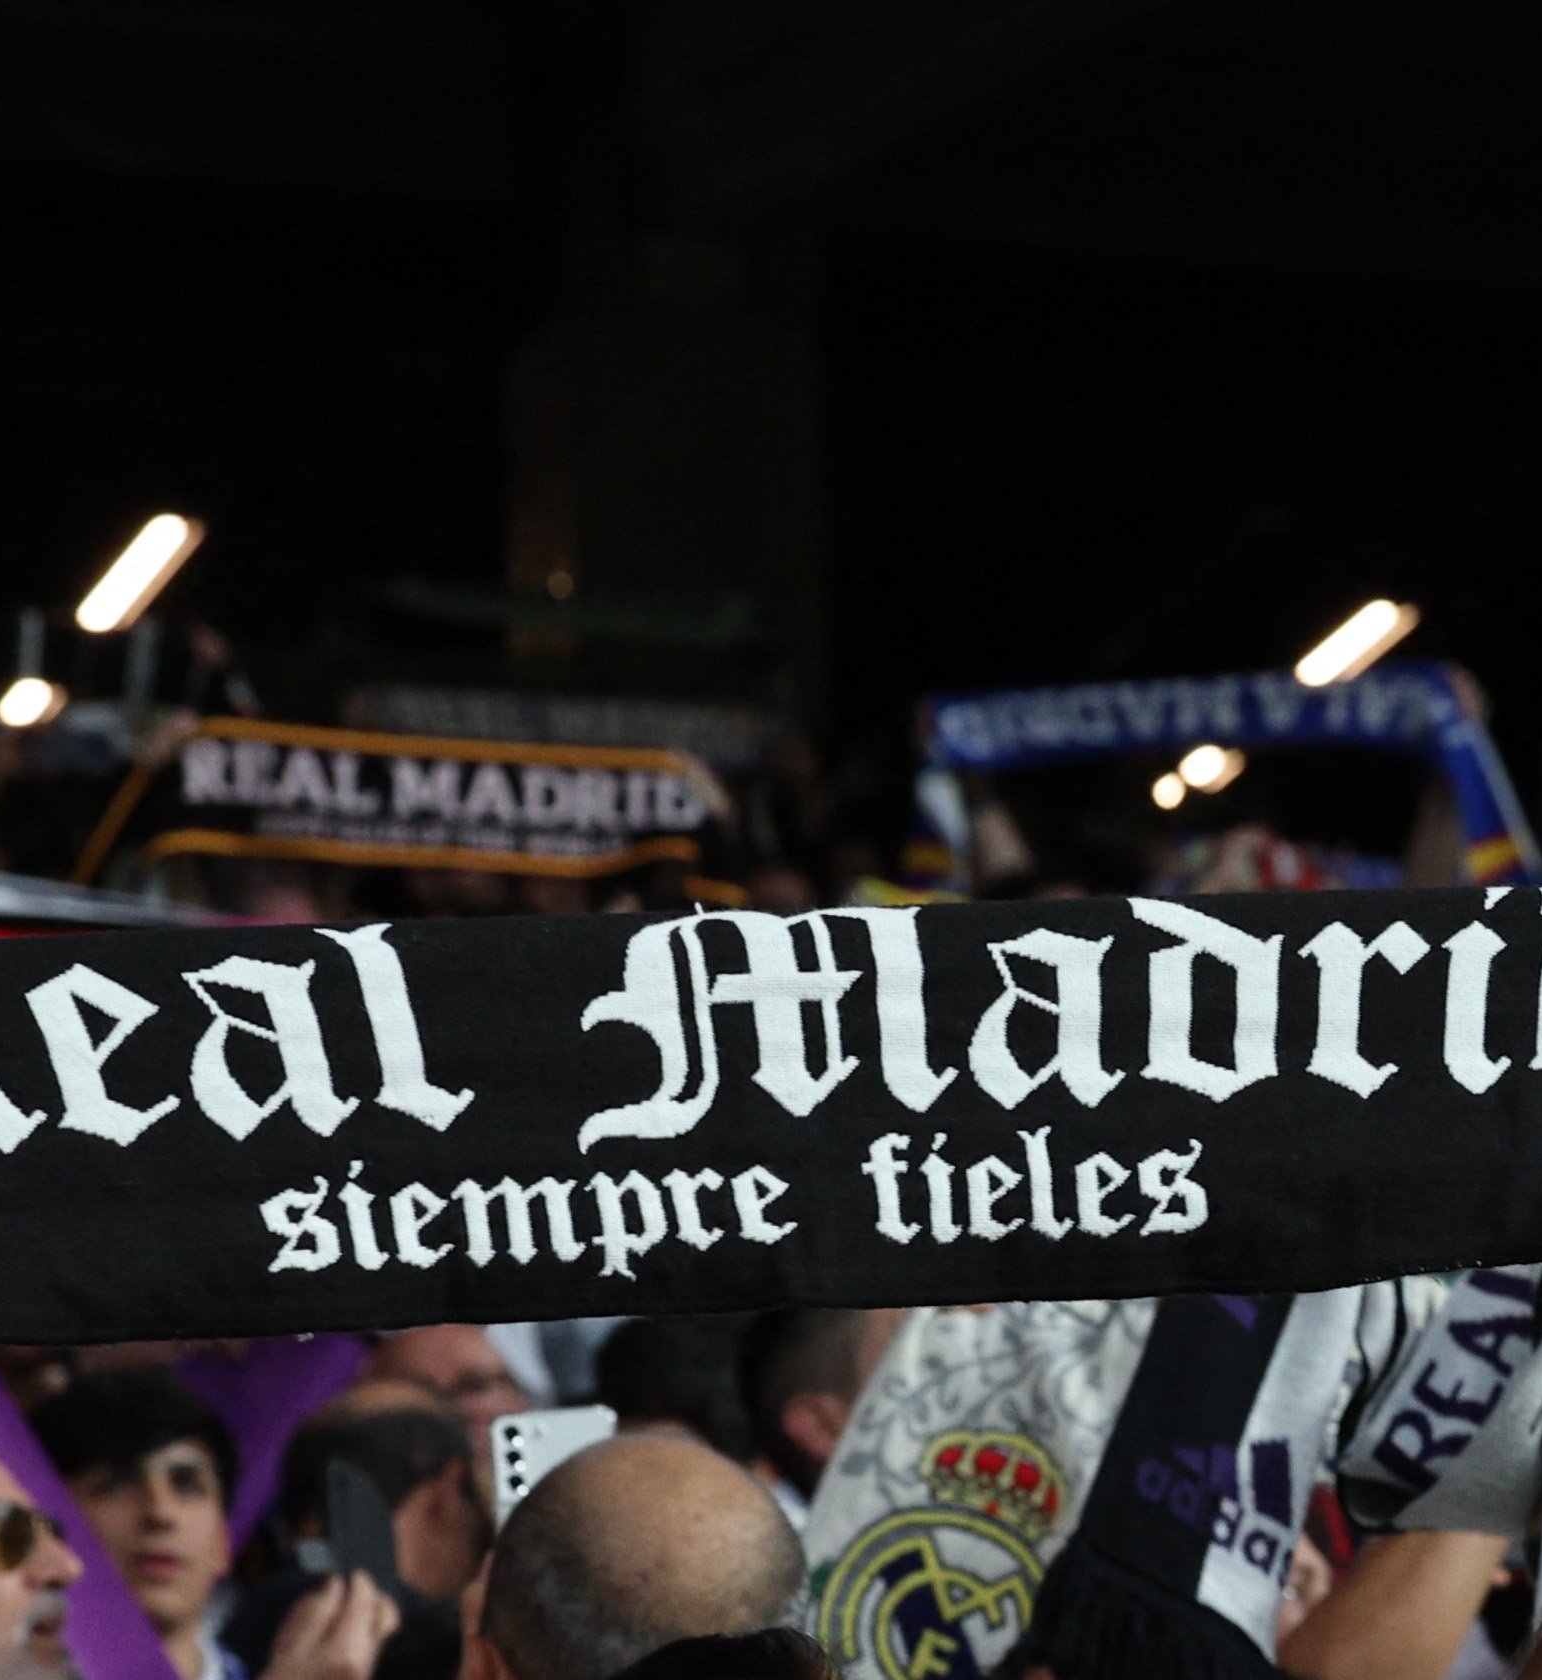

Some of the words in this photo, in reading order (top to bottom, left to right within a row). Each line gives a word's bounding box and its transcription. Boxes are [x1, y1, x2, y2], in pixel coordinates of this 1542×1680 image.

[181, 737, 384, 812] REAL
[392, 757, 709, 830] MADRID
[258, 1159, 800, 1281] siempre
[860, 1124, 1212, 1246] fieles
